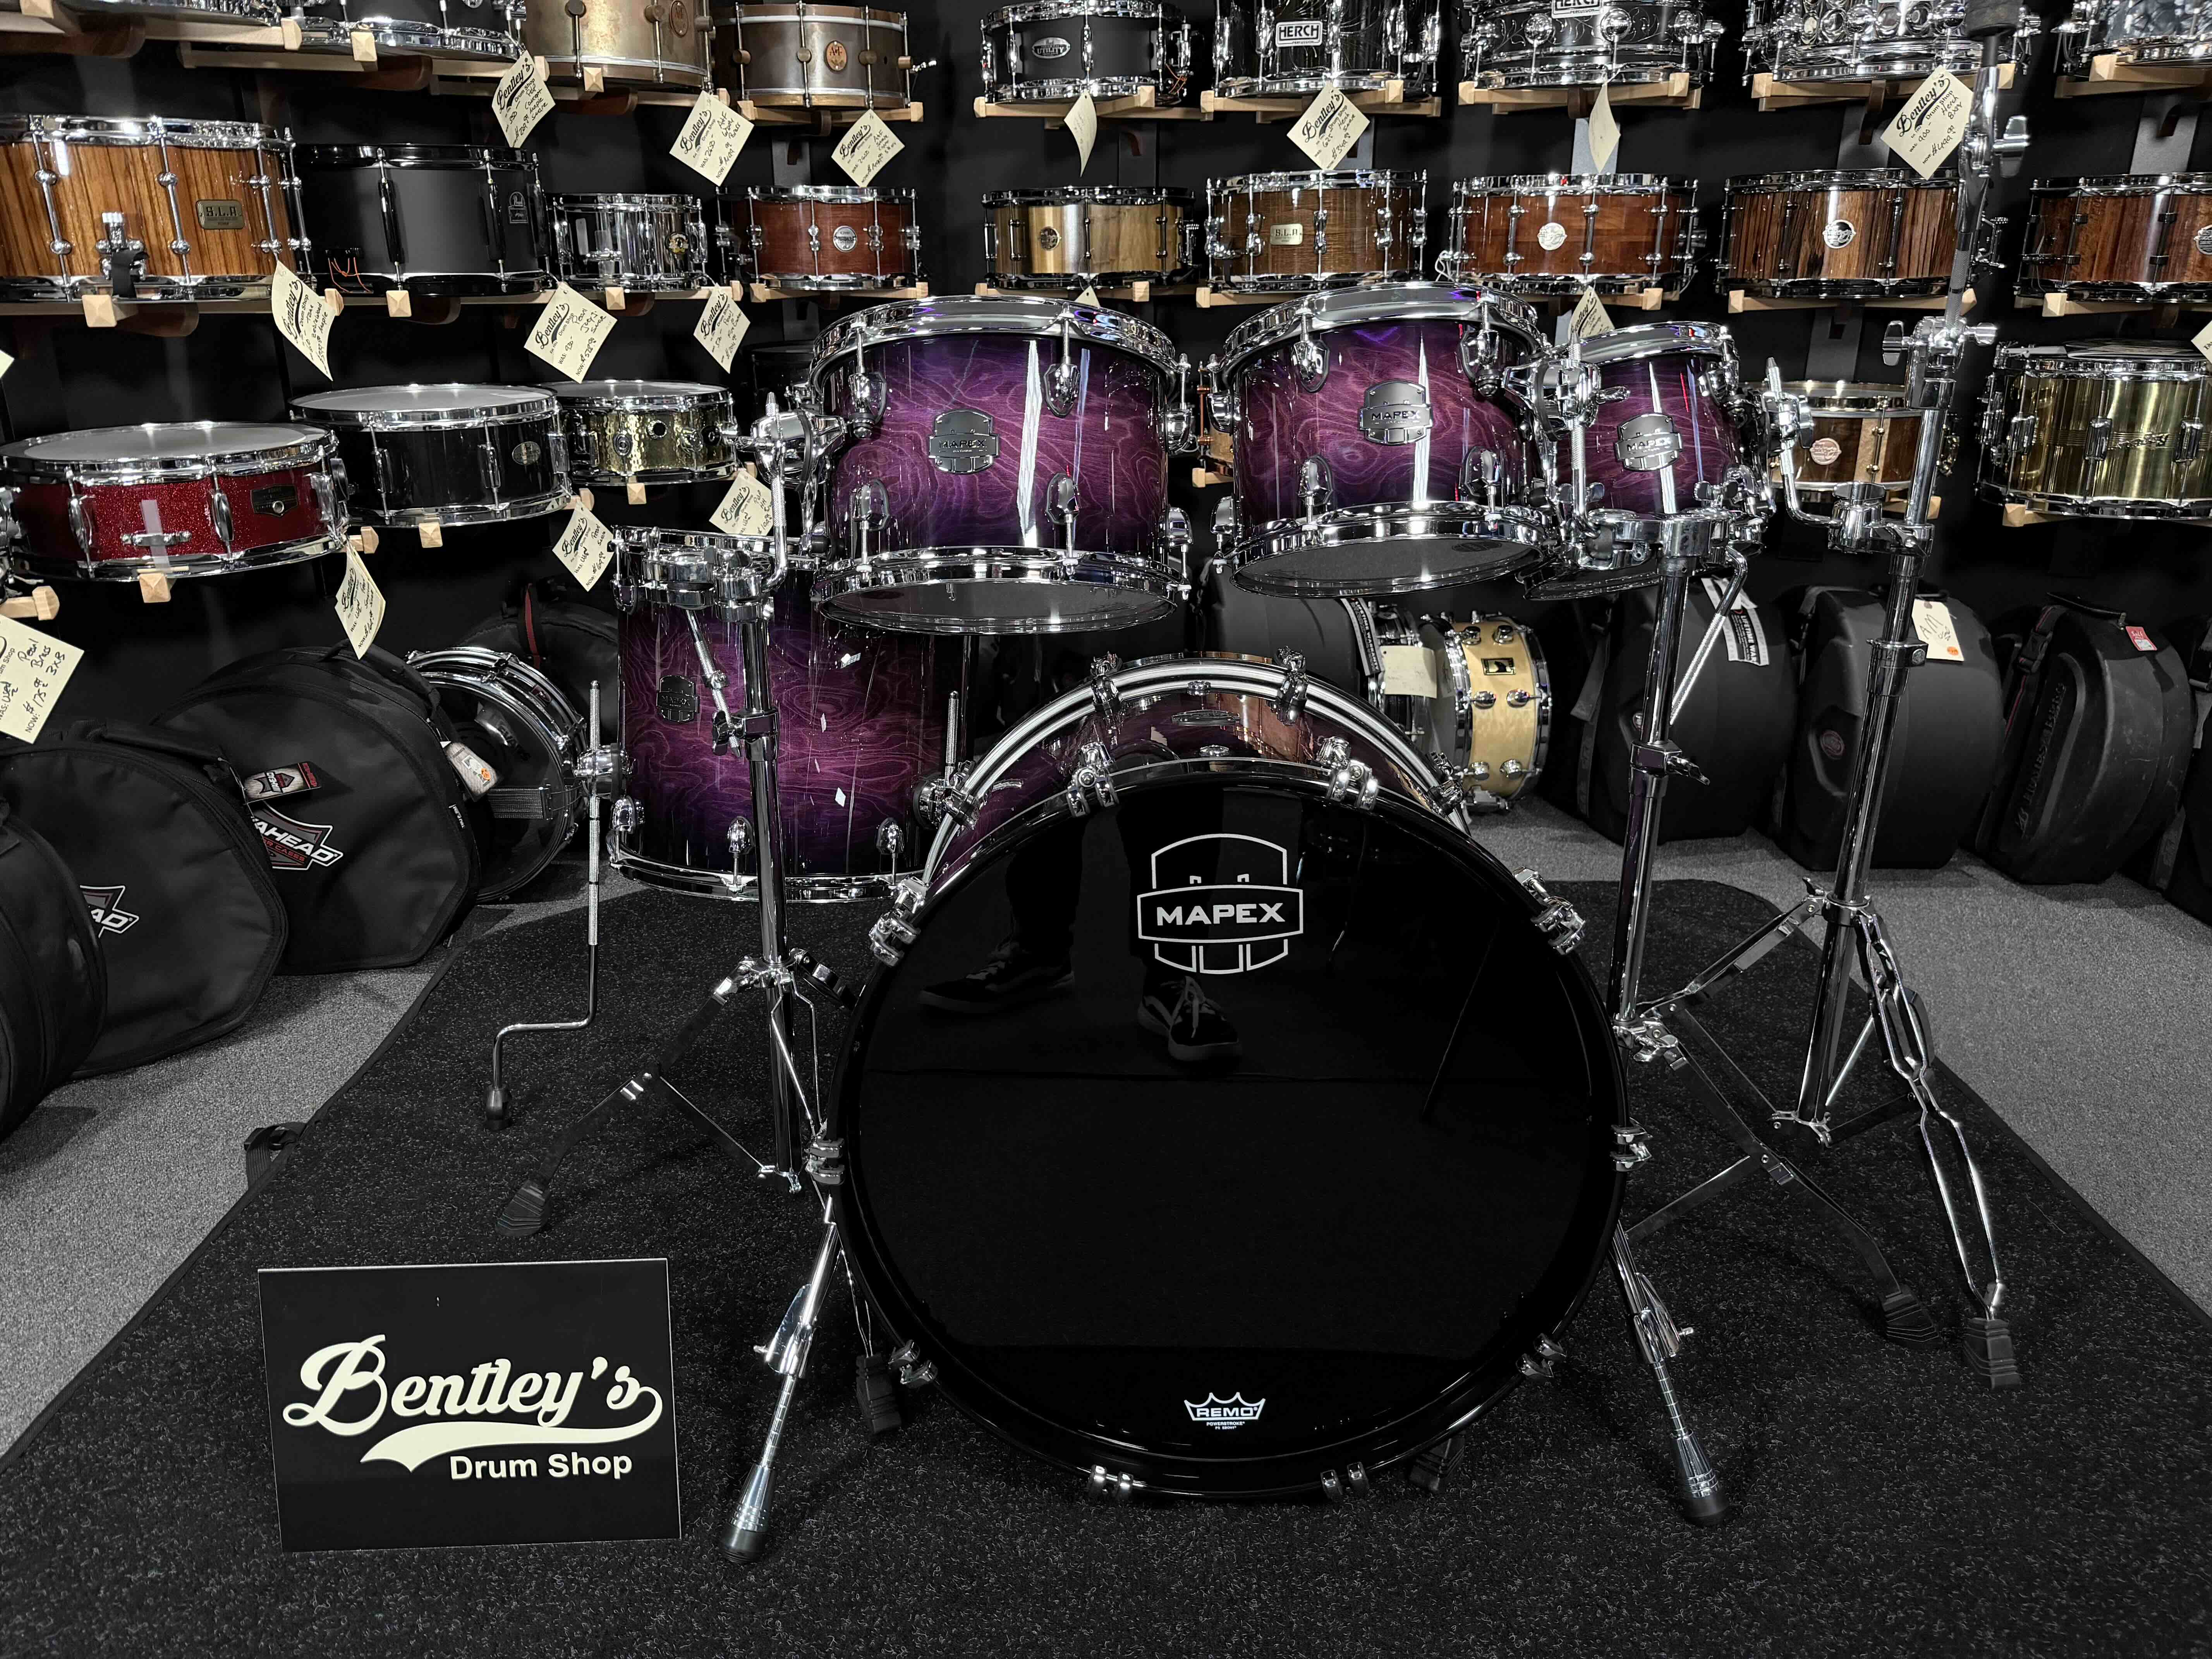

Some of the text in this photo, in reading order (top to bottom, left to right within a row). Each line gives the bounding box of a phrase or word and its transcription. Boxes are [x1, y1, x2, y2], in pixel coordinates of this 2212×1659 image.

[1279, 25, 1319, 38] HERCH
[497, 63, 534, 114] Bentley's
[514, 78, 536, 103] Drum Shop
[1302, 93, 1344, 143] Bentley's
[1328, 105, 1347, 129] Drum Shop
[1896, 78, 1950, 137] Bentley's
[1925, 90, 1953, 120] Drum Shop
[680, 110, 711, 154] Bentley's
[840, 124, 871, 160] Bentley's
[282, 280, 302, 344] Bentley's
[535, 303, 569, 349] Bentley's
[701, 293, 728, 340] Bentley's
[558, 323, 567, 336] Drum
[558, 353, 567, 364] WAS:
[576, 363, 586, 376] NOW:
[1372, 410, 1421, 421] MAPEX
[939, 439, 987, 448] MAPEX
[1627, 437, 1672, 452] MAPEX
[721, 486, 750, 524] Bentley's
[562, 517, 587, 557] Bentley's
[1355, 601, 1370, 630] LIFETIME
[1367, 631, 1379, 670] WARRANTY
[1741, 615, 1754, 644] LIFETIME
[6, 647, 15, 664] Shop
[25, 713, 40, 733] NOW:
[254, 819, 335, 862] AHEAD
[1156, 902, 1286, 926] MAPEX
[283, 1334, 662, 1439] Bentley's
[450, 1451, 633, 1480] Drum Shop
